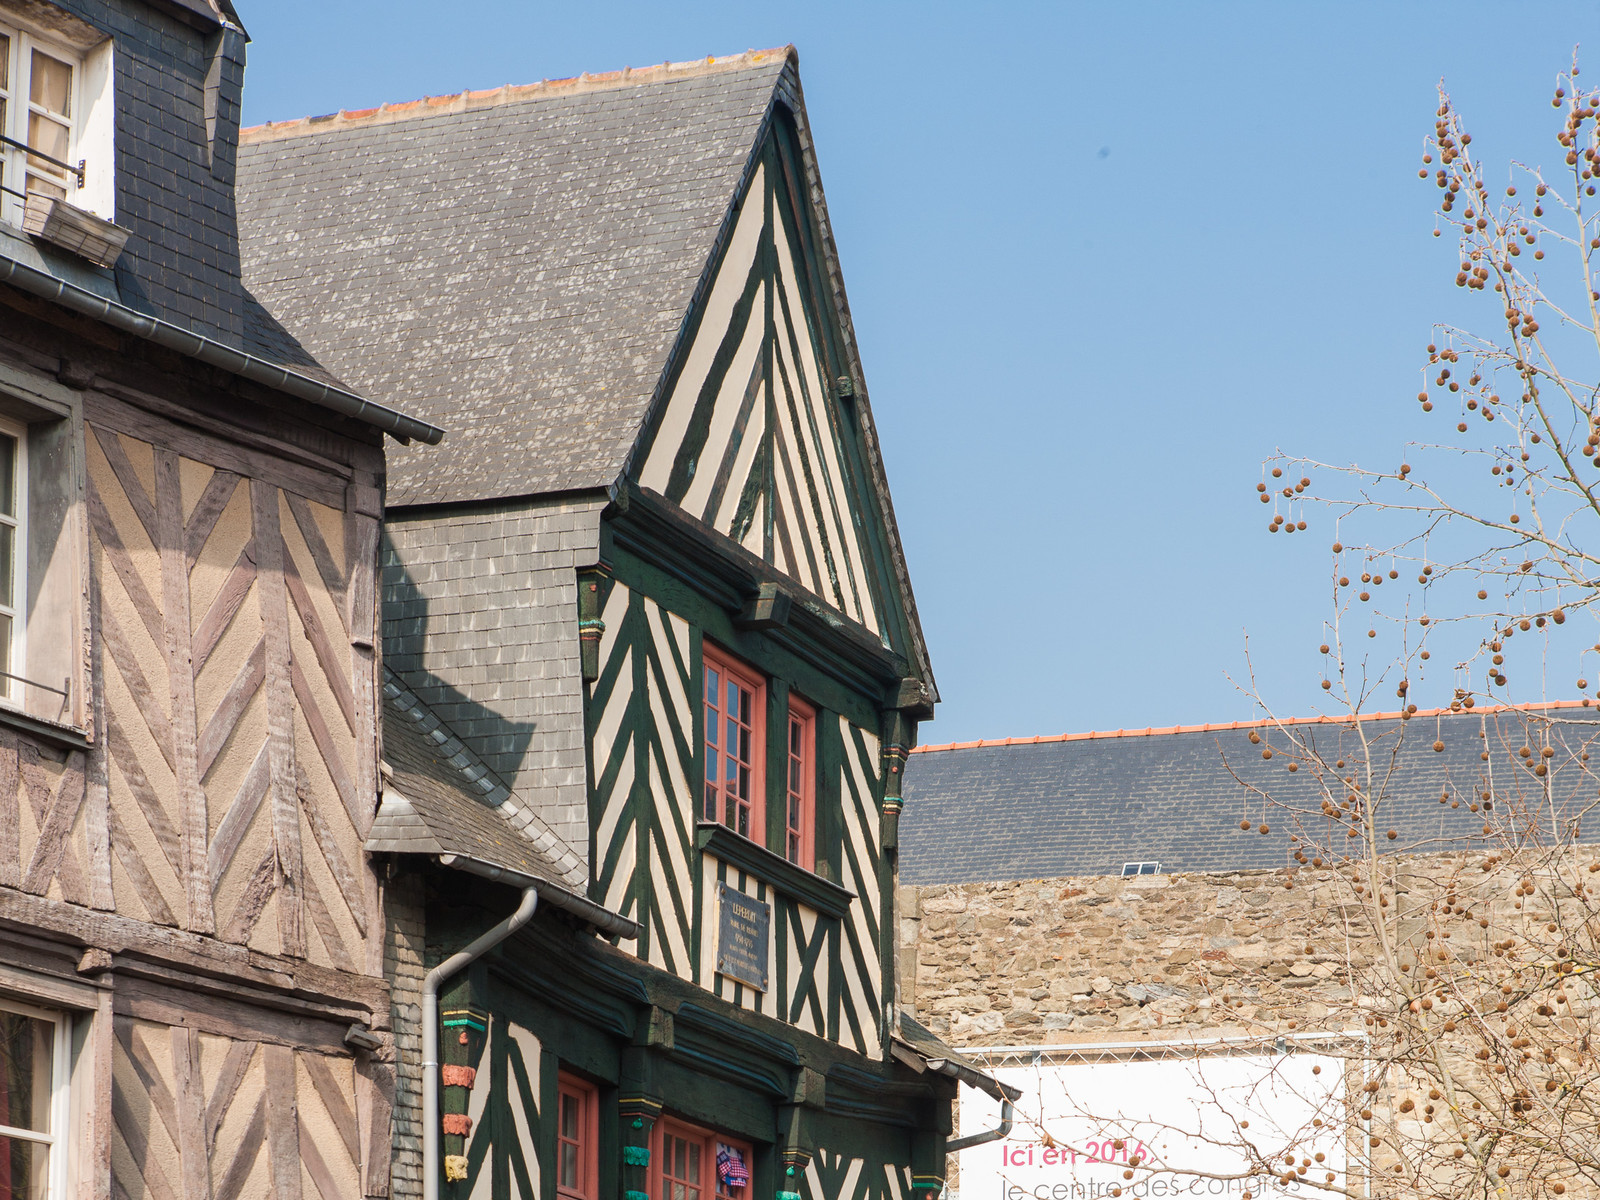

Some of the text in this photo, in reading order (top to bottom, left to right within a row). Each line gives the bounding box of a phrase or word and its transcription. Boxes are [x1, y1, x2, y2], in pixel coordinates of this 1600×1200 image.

[1003, 1143, 1034, 1166] Ici
[1042, 1148, 1077, 1166] en
[1034, 1176, 1122, 1200] centre
[1132, 1175, 1179, 1198] des
